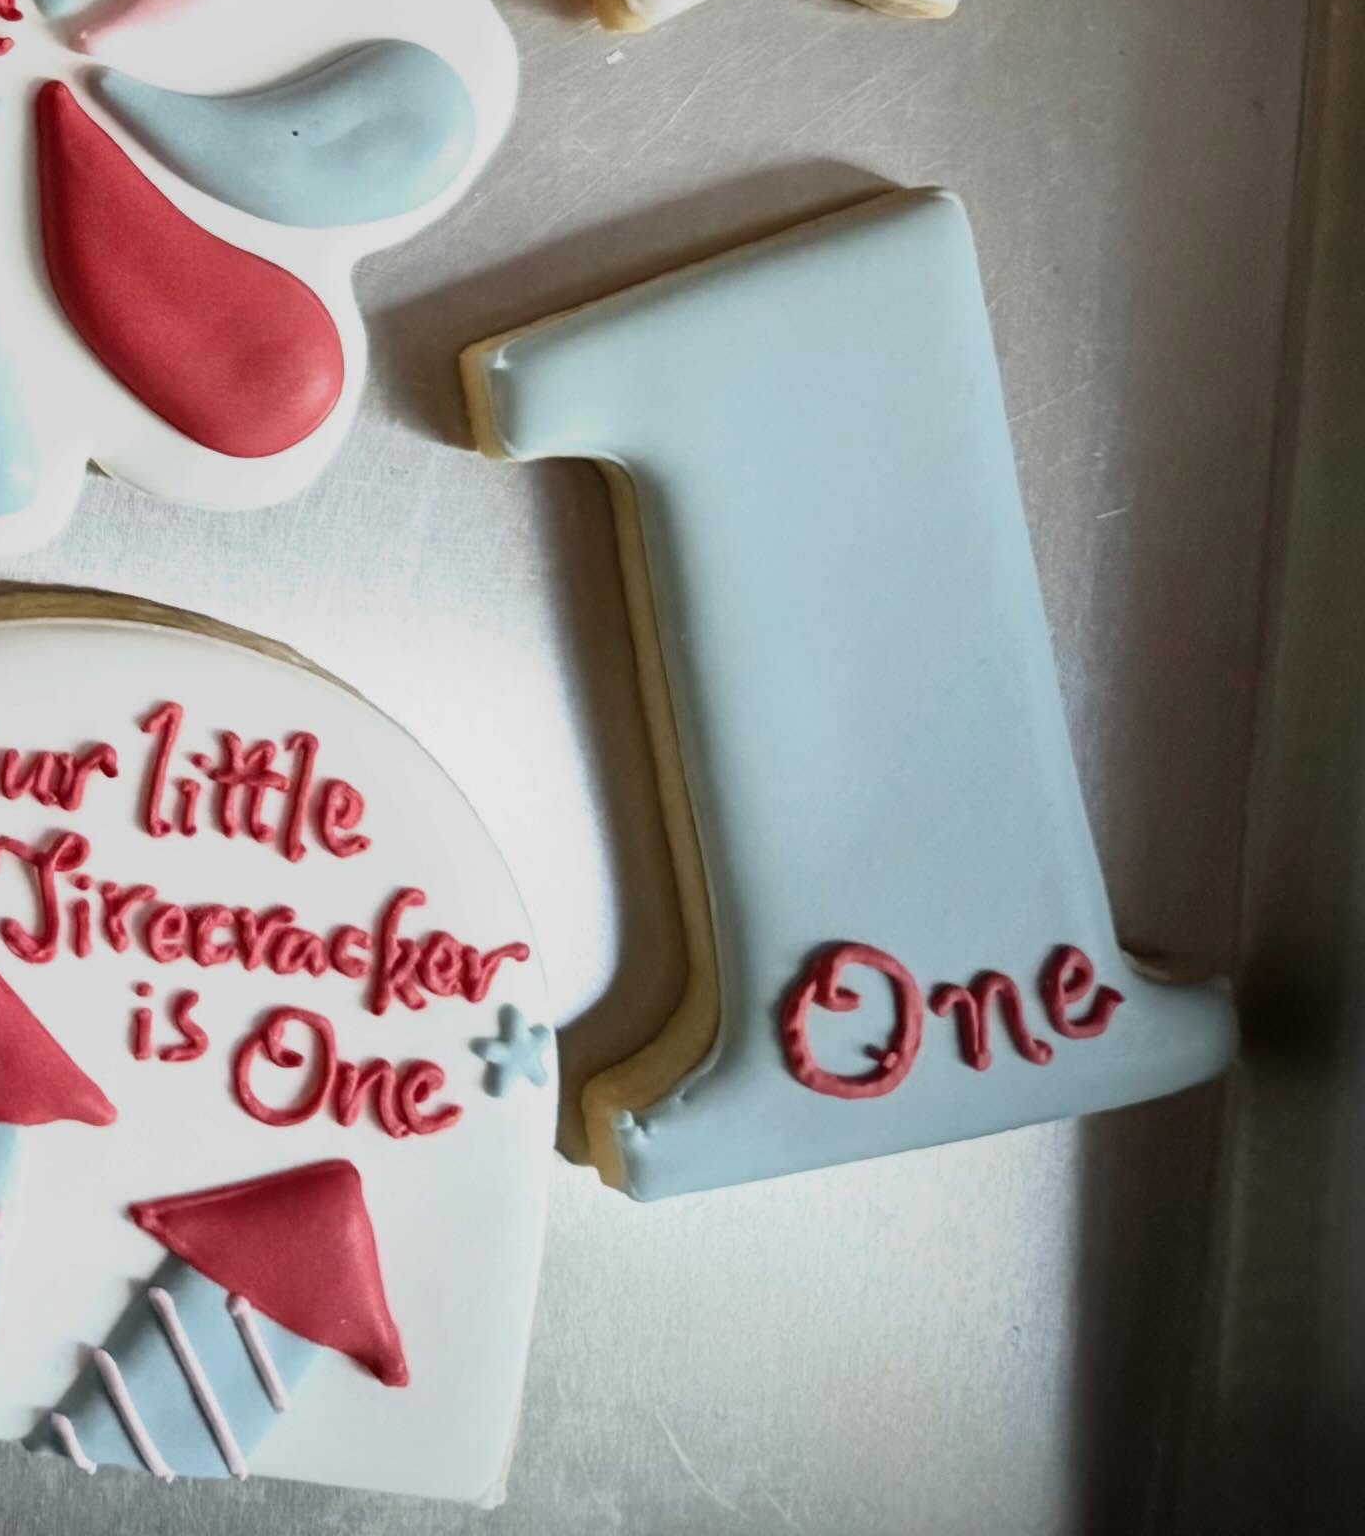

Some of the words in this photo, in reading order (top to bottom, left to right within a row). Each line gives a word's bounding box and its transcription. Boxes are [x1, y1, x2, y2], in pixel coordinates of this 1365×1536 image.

[140, 701, 371, 863] little
[131, 981, 210, 1062] is
[230, 1004, 464, 1139] One
[780, 940, 1125, 1100] One
